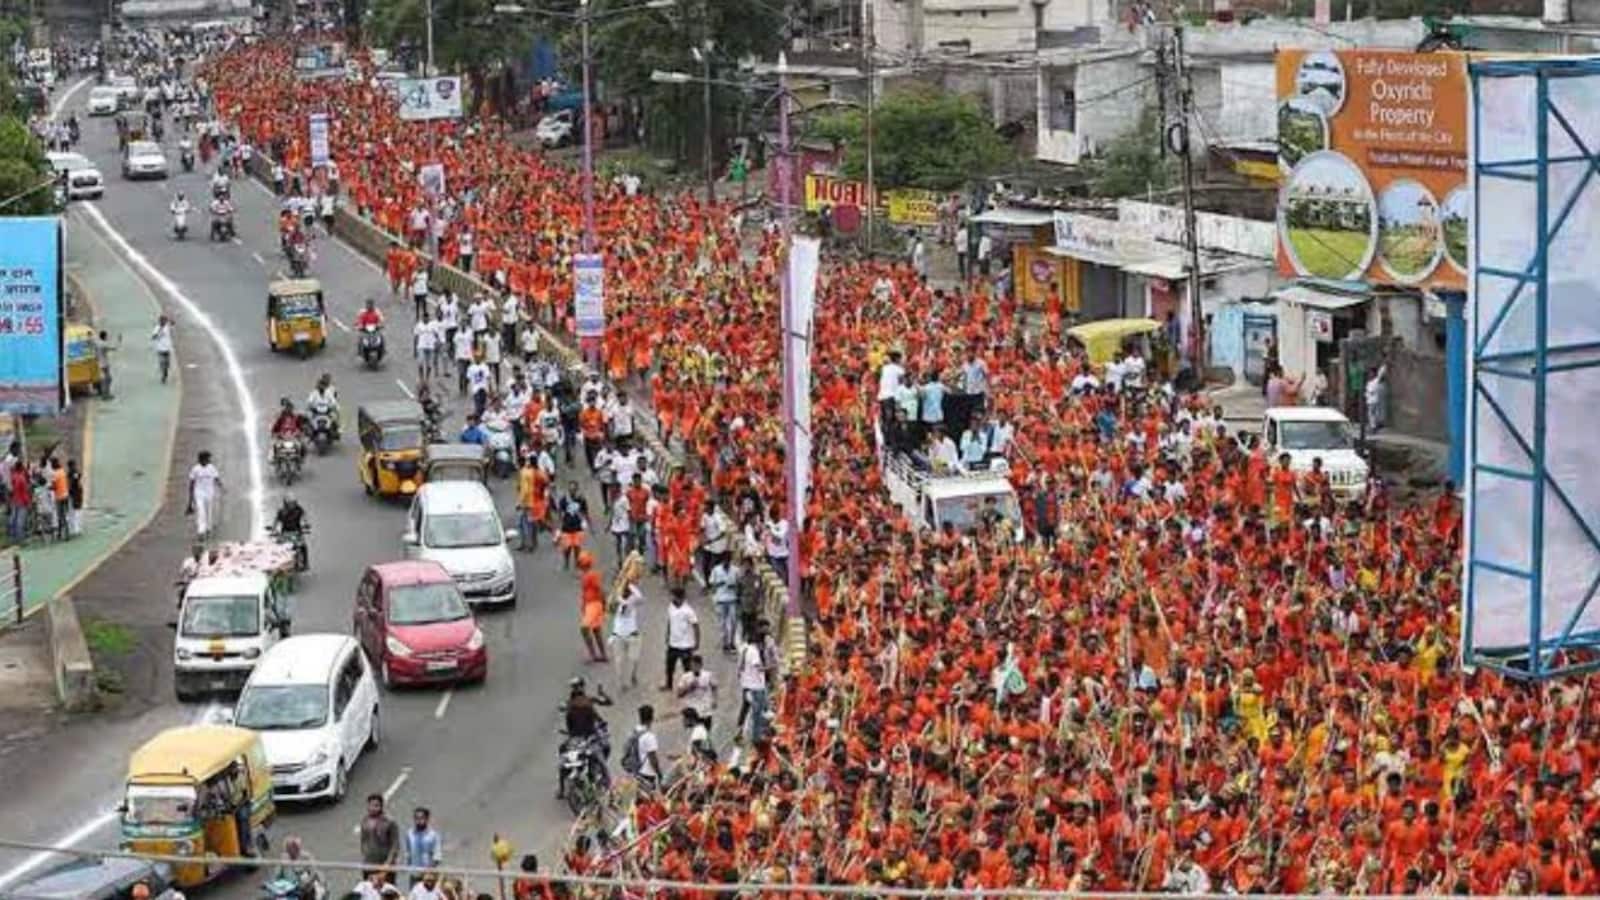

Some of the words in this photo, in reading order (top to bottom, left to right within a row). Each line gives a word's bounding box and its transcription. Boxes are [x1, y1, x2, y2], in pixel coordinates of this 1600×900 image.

[1356, 58, 1384, 77] Fully
[1387, 59, 1448, 77] Developed
[1371, 79, 1433, 102] Oxyrich
[1370, 102, 1435, 128] Property
